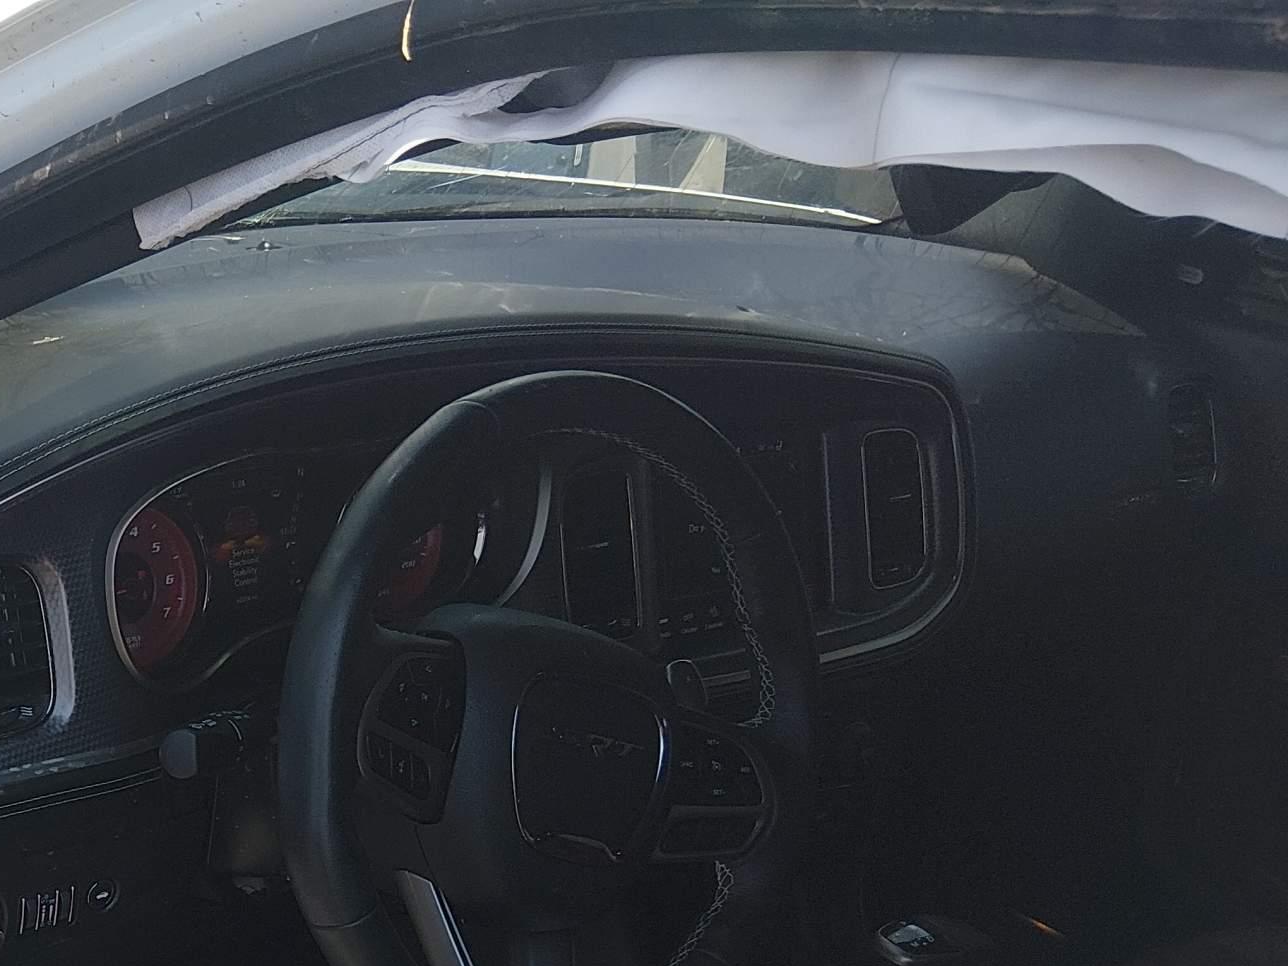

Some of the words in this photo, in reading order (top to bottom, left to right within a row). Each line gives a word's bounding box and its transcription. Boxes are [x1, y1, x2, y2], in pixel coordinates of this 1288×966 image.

[129, 526, 139, 537] 4
[152, 542, 161, 553] 5
[165, 574, 175, 585] 6
[162, 607, 172, 619] 7
